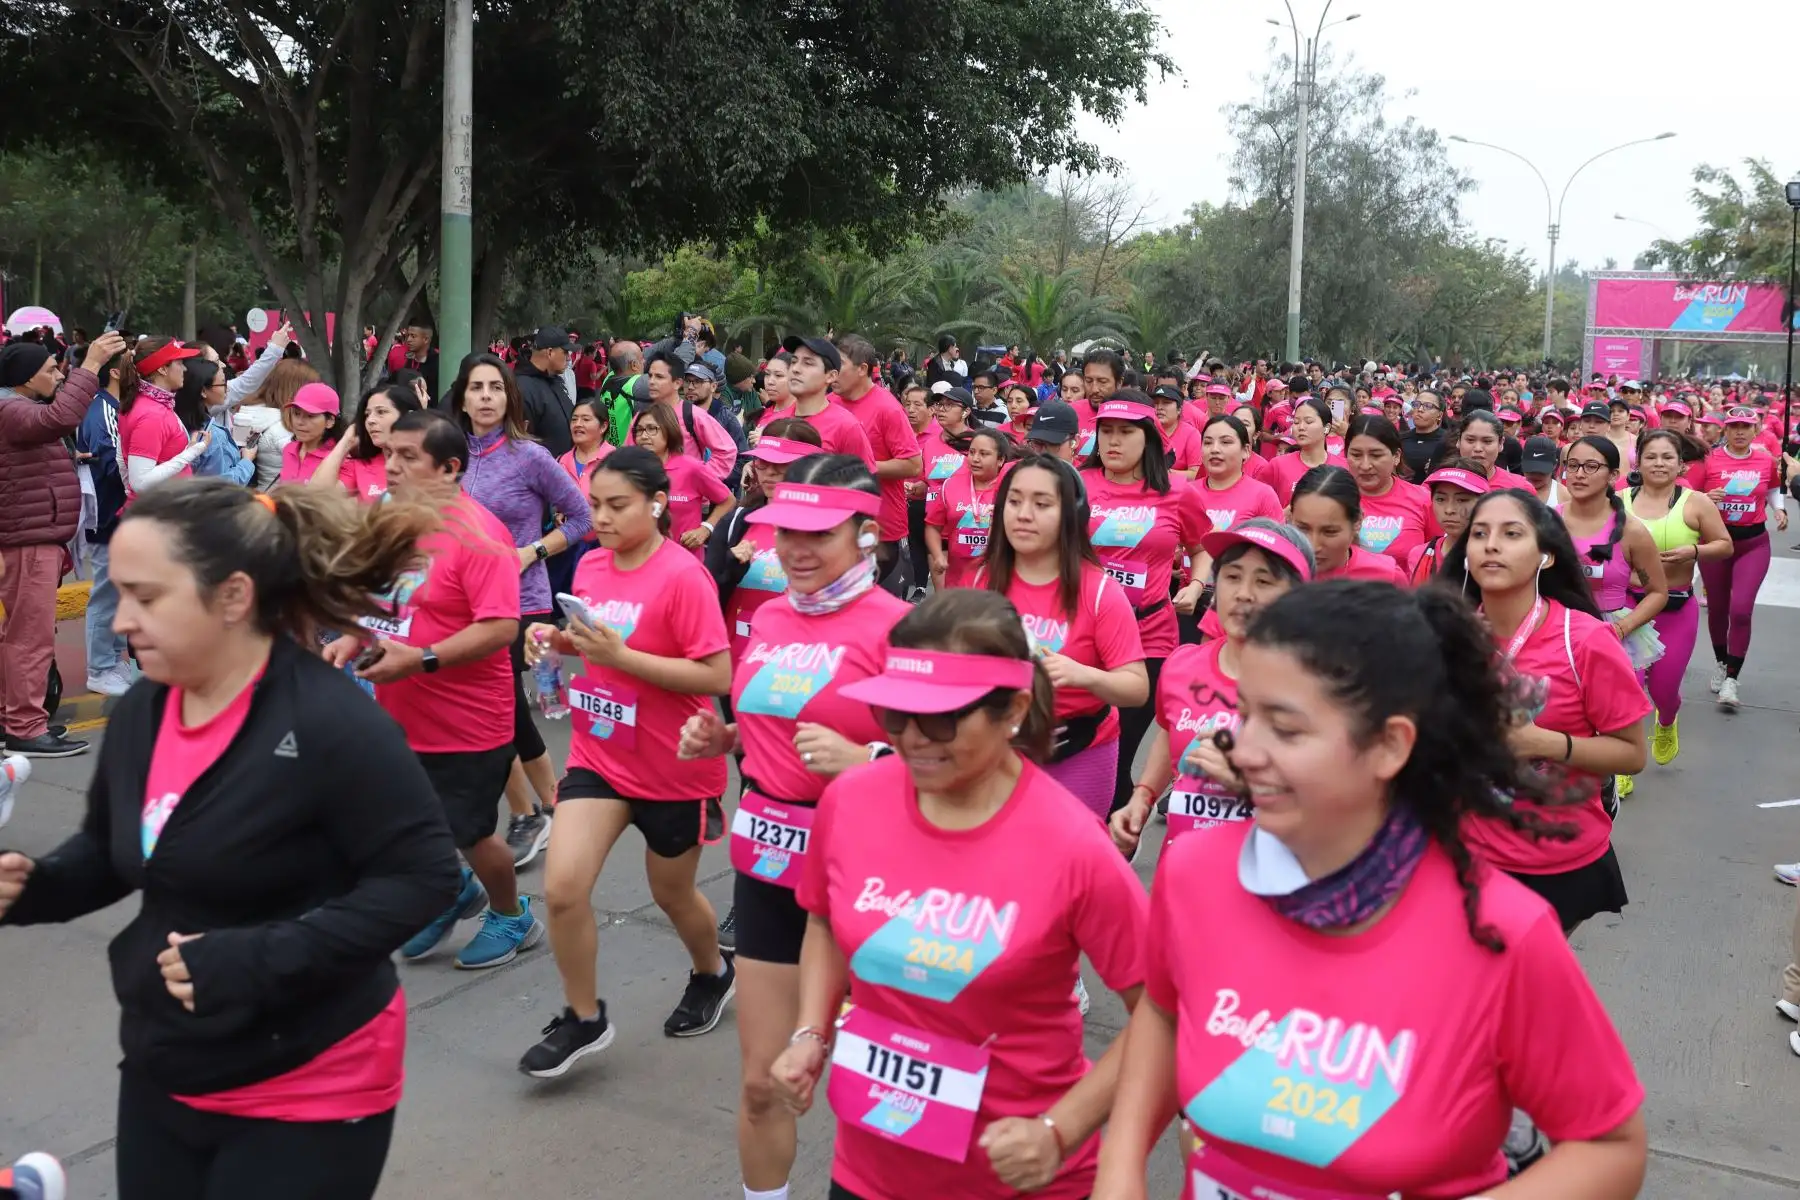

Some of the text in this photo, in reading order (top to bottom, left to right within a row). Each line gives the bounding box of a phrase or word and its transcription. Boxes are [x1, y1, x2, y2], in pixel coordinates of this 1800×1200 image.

[1703, 284, 1748, 304] RUN
[1115, 506, 1156, 521] RUN
[1723, 503, 1751, 512] 12447
[1365, 515, 1404, 529] RUN
[965, 535, 988, 545] 1109
[778, 642, 846, 678] RUN
[769, 673, 813, 695] 2024
[579, 693, 623, 721] 11648
[1184, 793, 1253, 820] 10974
[750, 817, 806, 852] 12371
[914, 887, 1019, 950] RUN
[904, 937, 975, 974] 2024
[1205, 988, 1418, 1095] Barbie RUN
[866, 1044, 943, 1097] 11151
[1266, 1076, 1362, 1130] 2024
